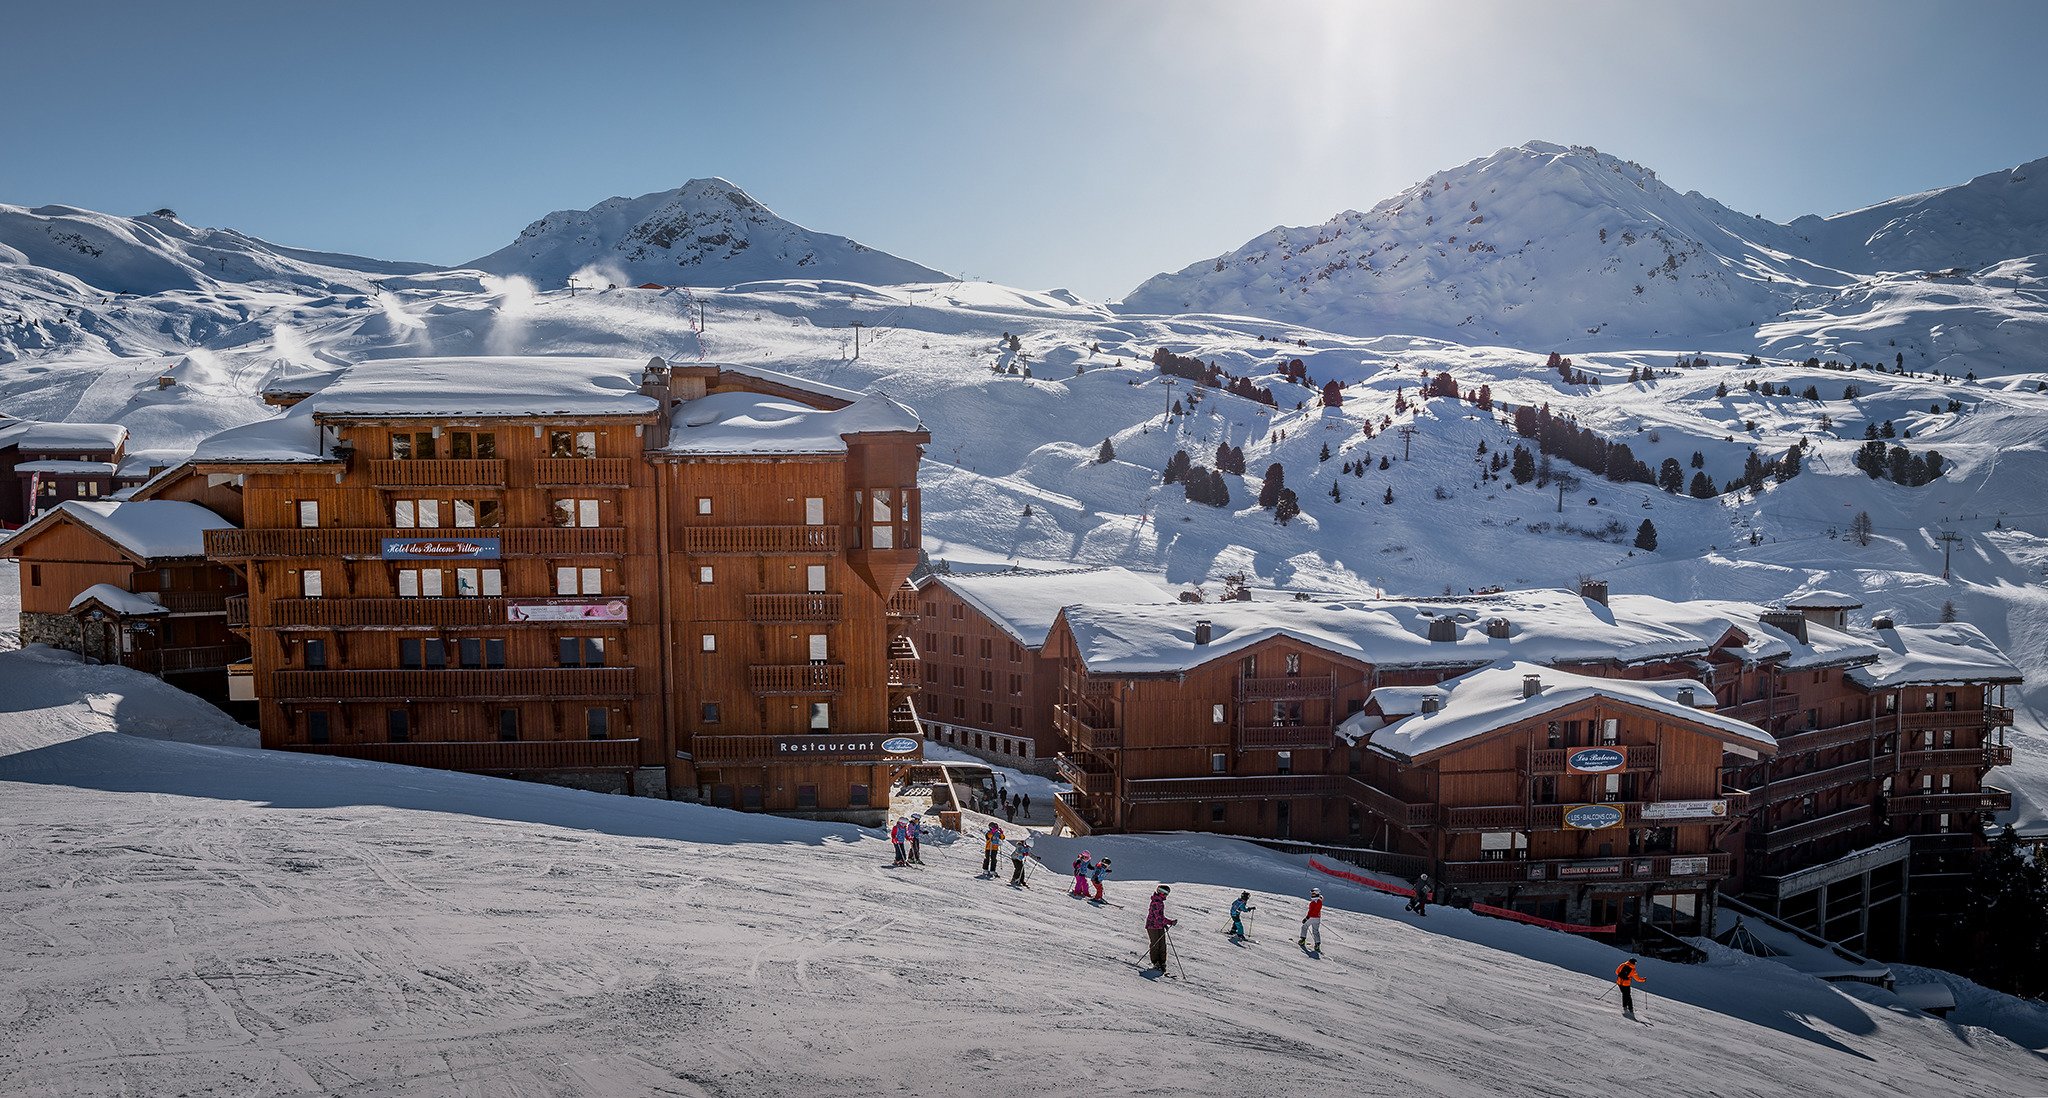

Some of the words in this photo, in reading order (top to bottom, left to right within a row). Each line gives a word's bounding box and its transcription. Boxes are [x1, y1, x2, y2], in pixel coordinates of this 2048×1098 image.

[410, 543, 422, 553] des
[423, 543, 455, 553] Balcons
[456, 543, 484, 556] Village
[780, 741, 875, 752] Restaurant
